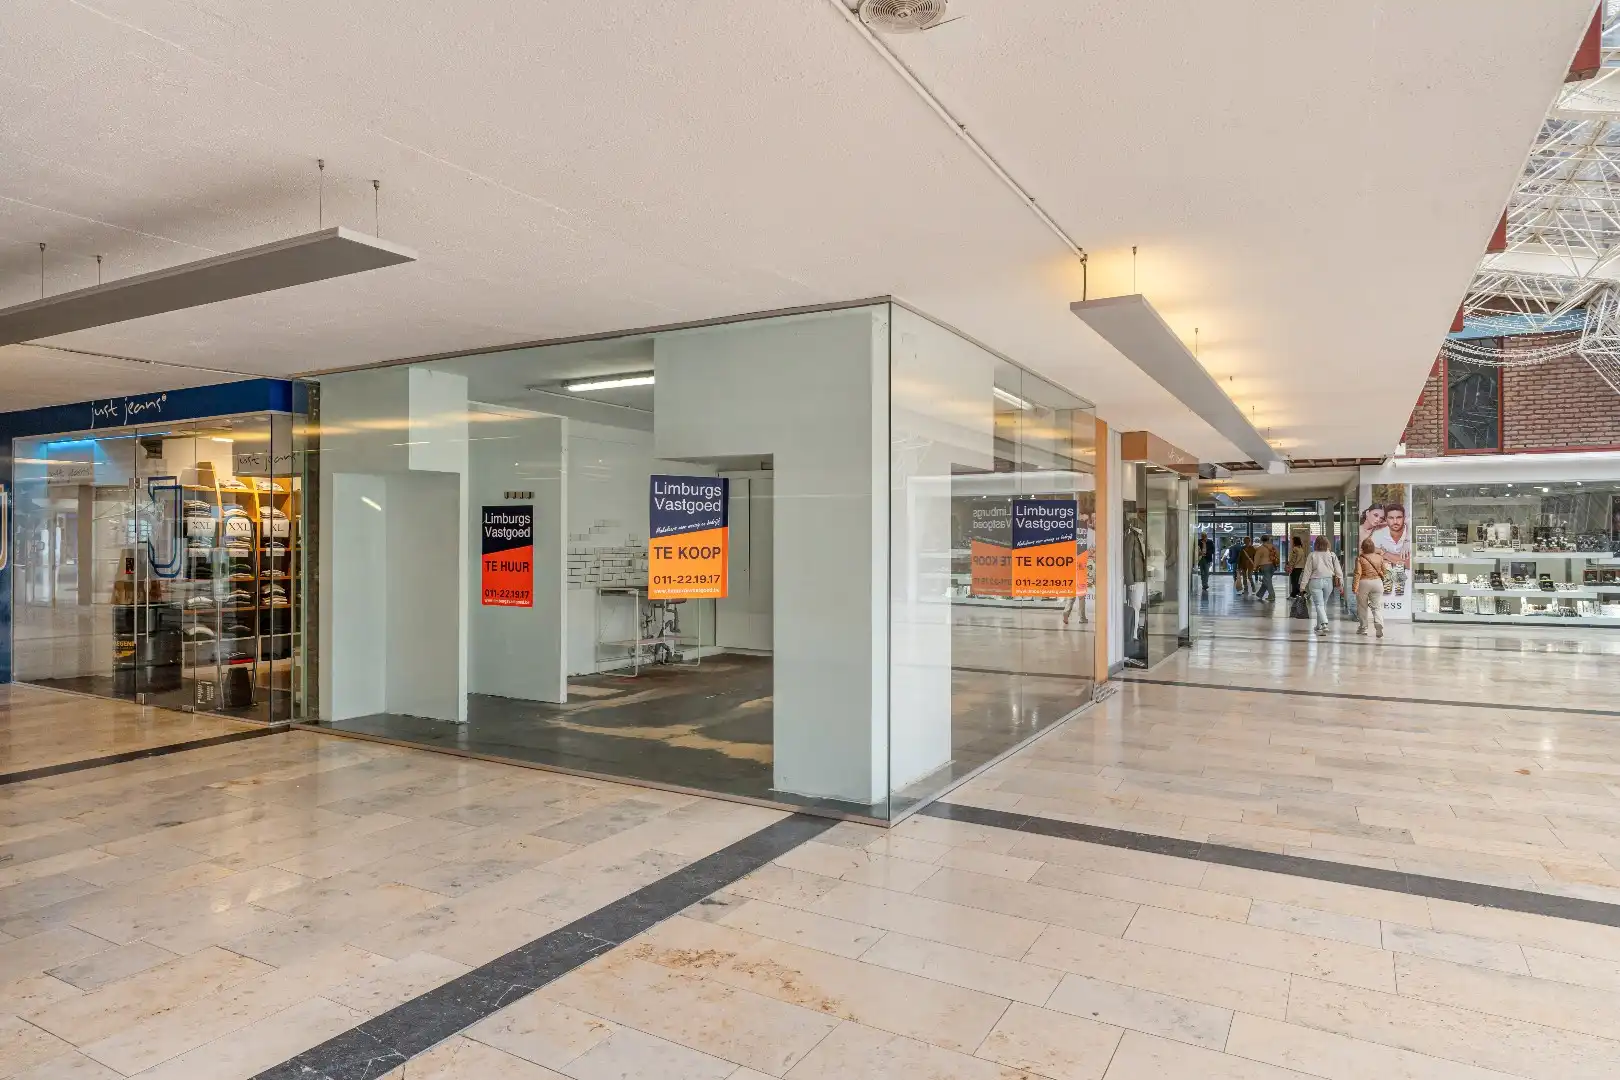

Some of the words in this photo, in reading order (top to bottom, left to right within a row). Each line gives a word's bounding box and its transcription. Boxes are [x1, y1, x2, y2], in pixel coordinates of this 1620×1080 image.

[91, 400, 118, 429] just
[654, 481, 722, 500] Limburgs
[654, 496, 721, 515] Vastgoed
[1015, 505, 1074, 519] Limburgs
[192, 521, 212, 530] XXL
[485, 512, 531, 527] Limburgs
[1015, 518, 1074, 531] Vastgoed
[229, 522, 251, 532] XXL
[484, 526, 531, 541] Vastgoed
[653, 546, 673, 560] TE
[678, 546, 722, 560] KOOP
[484, 560, 498, 572] TE
[500, 560, 530, 573] HUUR
[1015, 556, 1032, 567] TE
[1036, 556, 1074, 567] KOOP
[653, 574, 721, 585] 011-22.19.17
[1015, 578, 1074, 588] 011-22.19.17
[484, 588, 530, 600] 011-22.19.17
[1383, 602, 1402, 610] ESS
